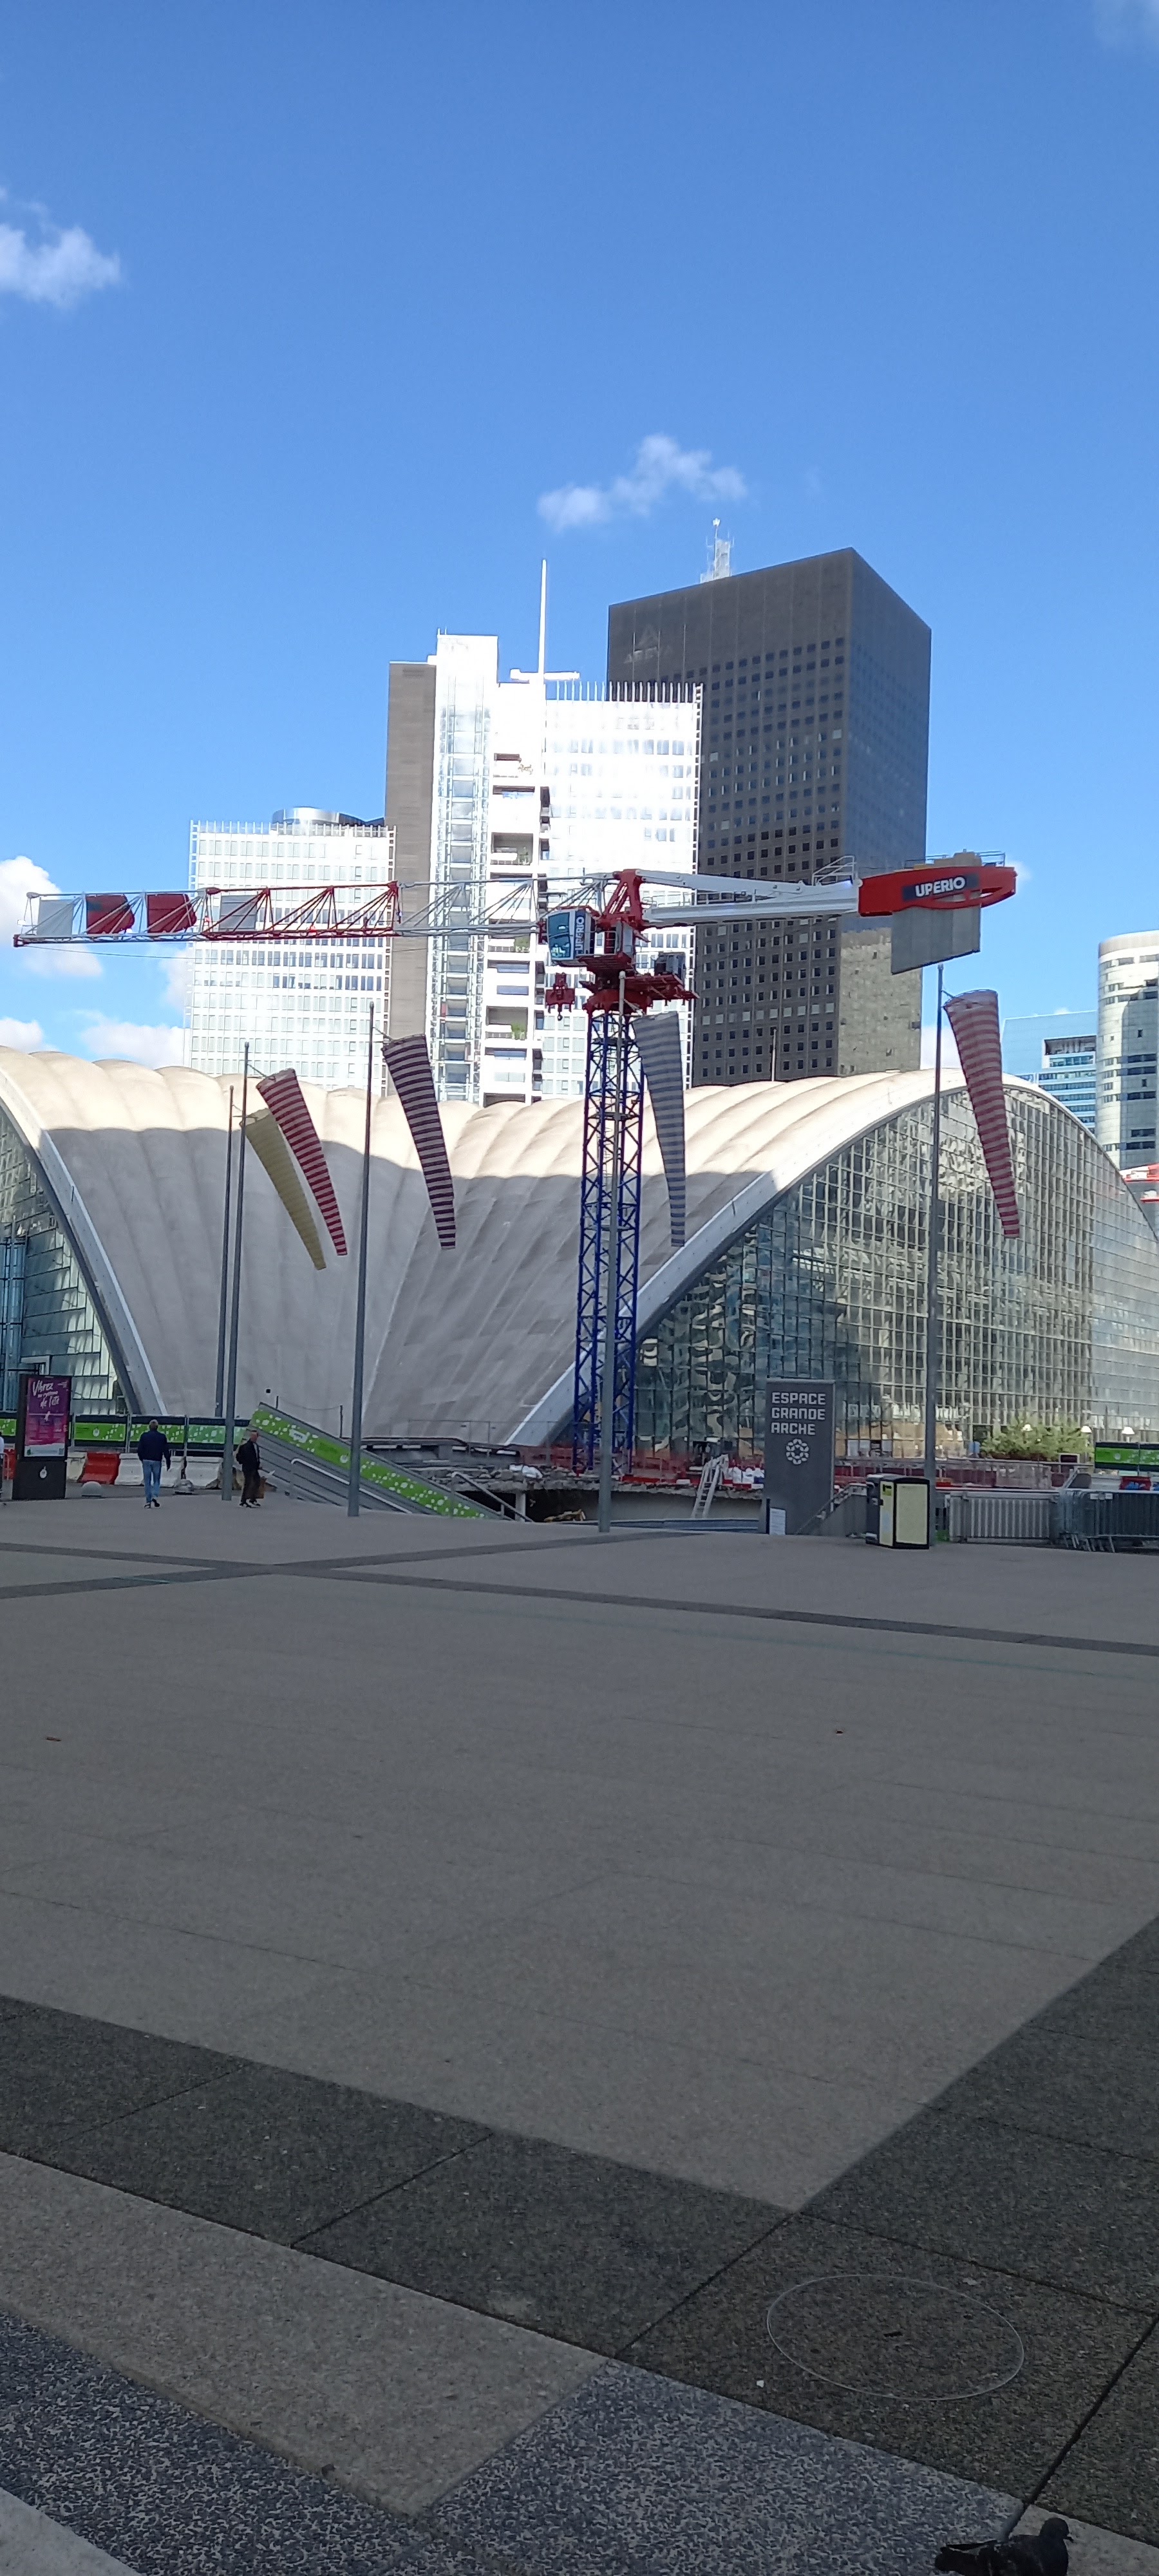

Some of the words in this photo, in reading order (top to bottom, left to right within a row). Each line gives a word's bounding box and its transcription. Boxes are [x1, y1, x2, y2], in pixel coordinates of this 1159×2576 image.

[915, 876, 966, 897] UPERIO
[574, 916, 585, 951] UPERIO
[771, 1392, 826, 1405] ESPACE
[771, 1407, 826, 1420] GRANDE
[771, 1422, 816, 1435] ARCHE
